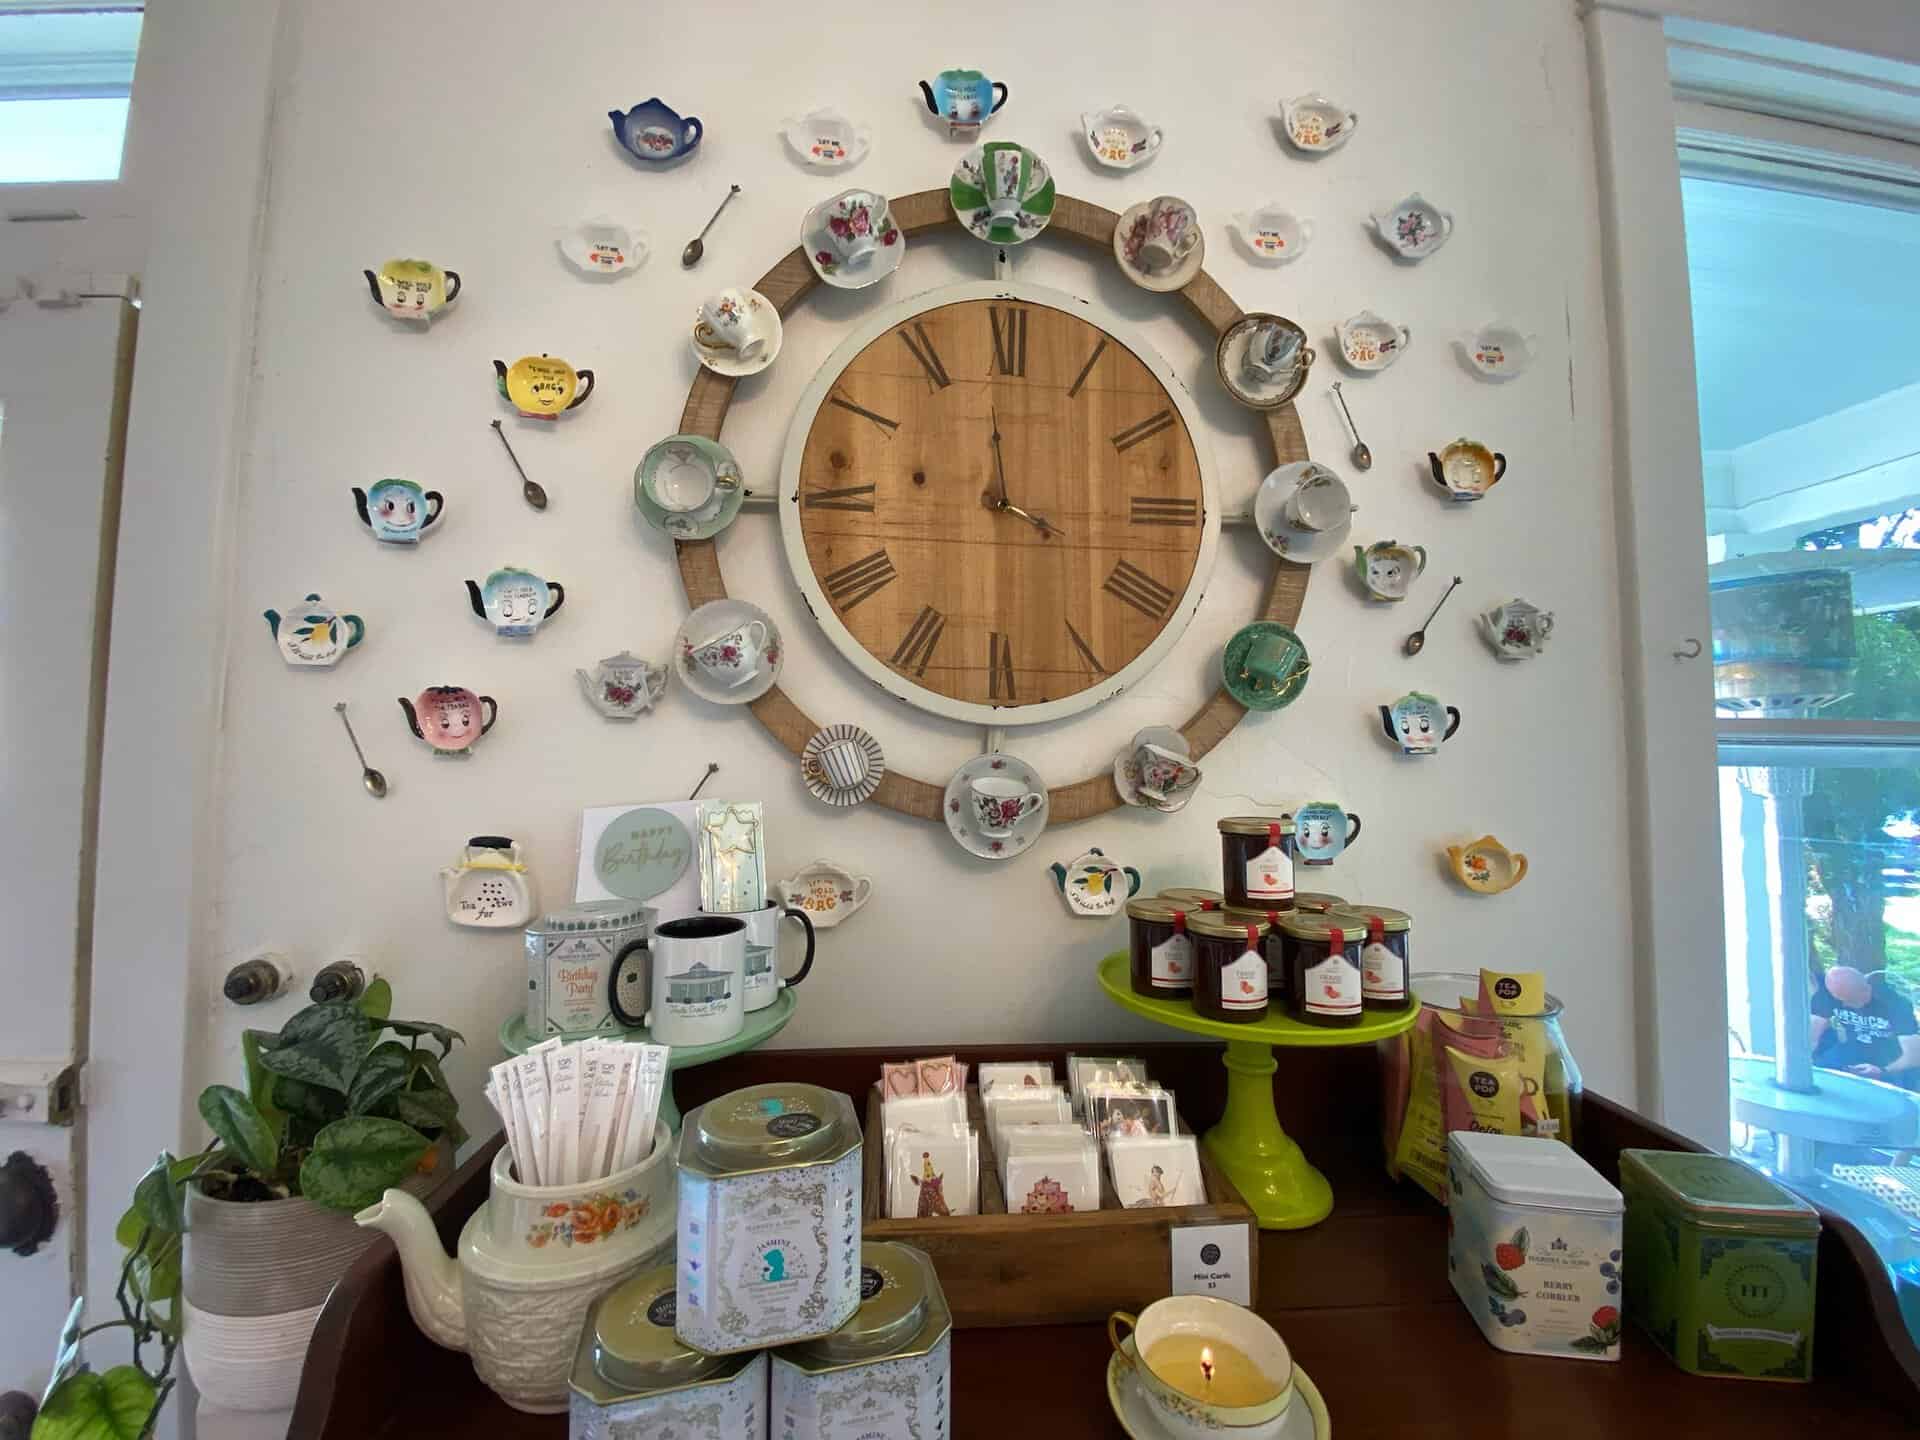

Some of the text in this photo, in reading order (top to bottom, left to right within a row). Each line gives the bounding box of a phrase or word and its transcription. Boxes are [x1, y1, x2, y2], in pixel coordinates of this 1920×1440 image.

[1497, 981, 1515, 990] TEA
[1499, 989, 1517, 998] POP
[1473, 1076, 1494, 1086] TEA
[1476, 1085, 1497, 1095] POP
[755, 1239, 789, 1252] JASMINE
[1210, 1272, 1231, 1280] Cards
[1542, 1280, 1573, 1290] BERRY
[1534, 1290, 1581, 1303] COBBLER
